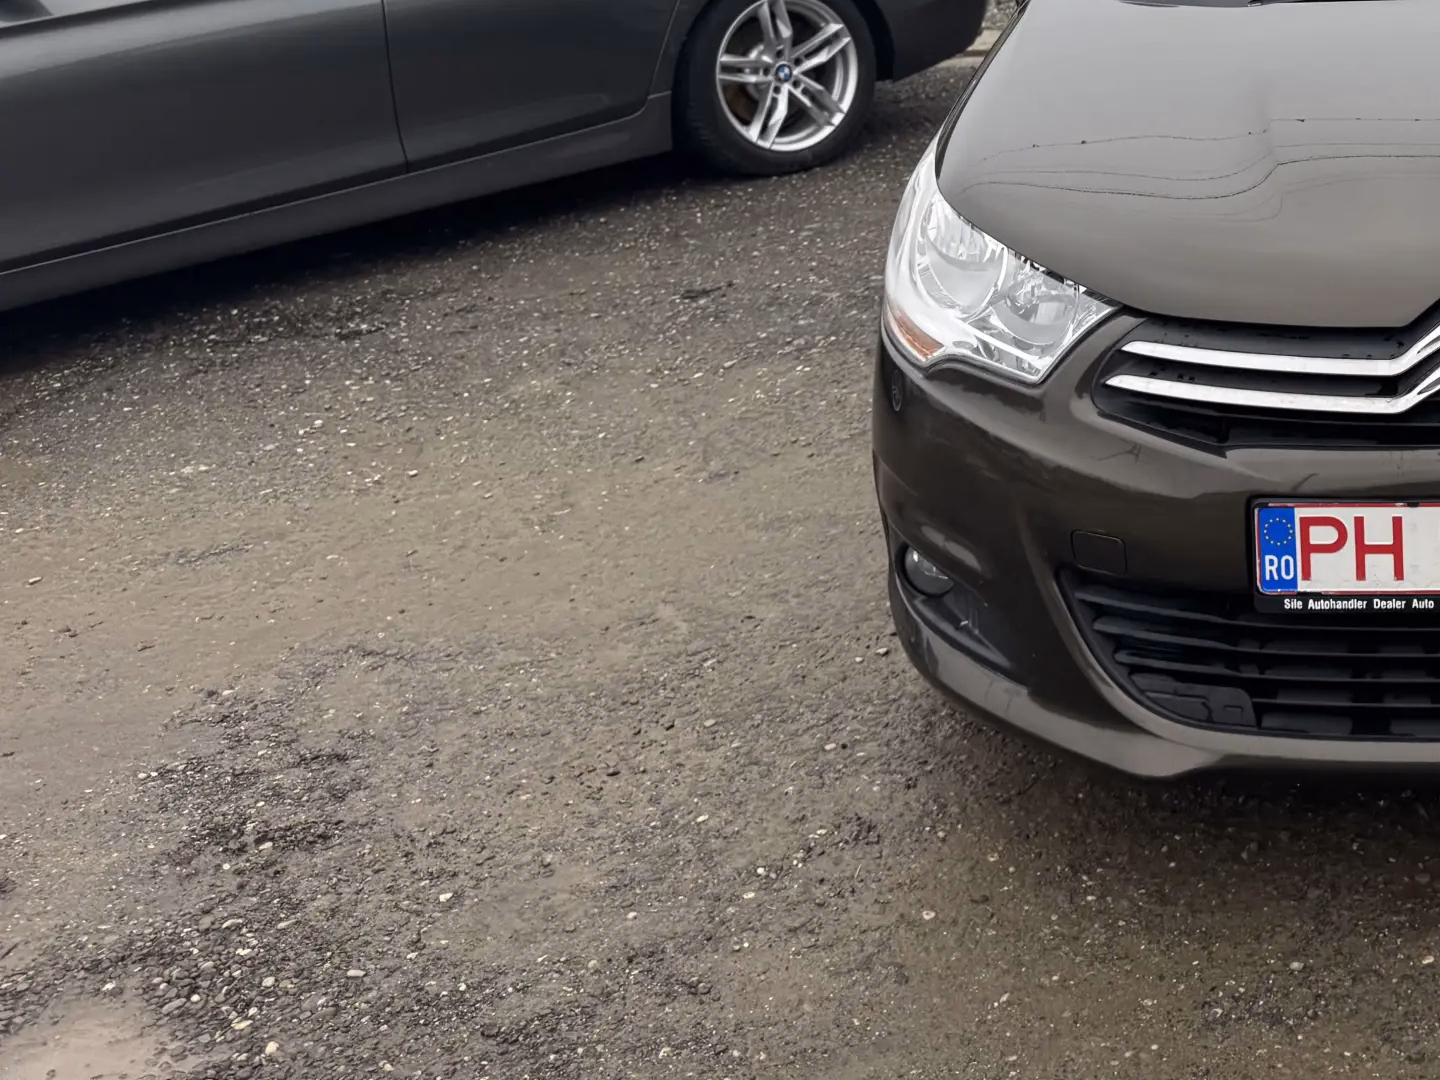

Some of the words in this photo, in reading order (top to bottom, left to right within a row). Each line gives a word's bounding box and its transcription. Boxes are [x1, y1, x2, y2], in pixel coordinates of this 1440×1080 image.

[1264, 554, 1294, 581] RO
[1299, 515, 1405, 582] PH
[1283, 598, 1303, 610] Sile
[1307, 598, 1368, 610] Autohandler
[1373, 598, 1406, 610] Dealer
[1411, 598, 1435, 610] Auto
